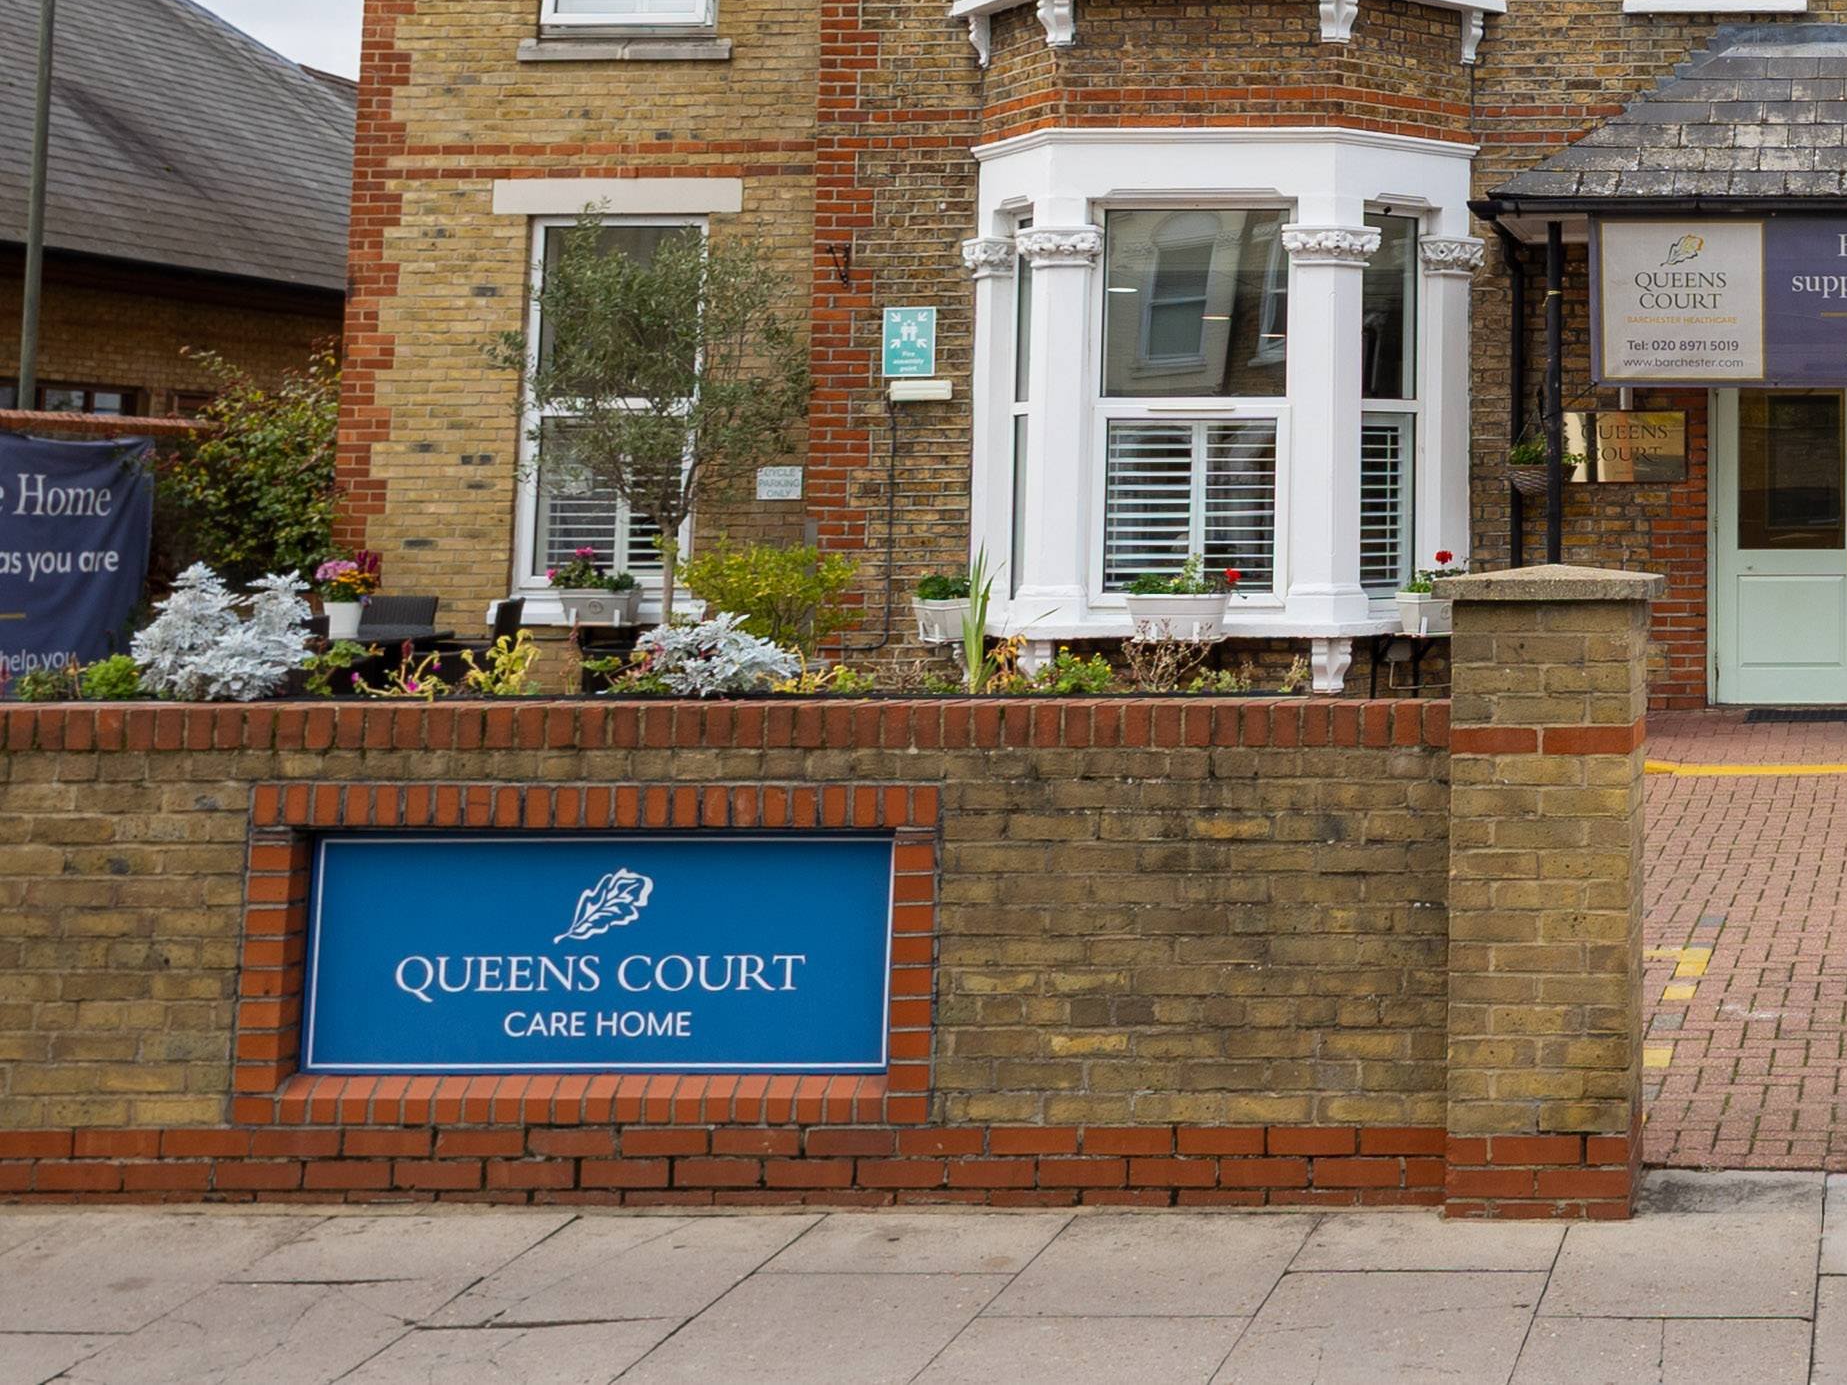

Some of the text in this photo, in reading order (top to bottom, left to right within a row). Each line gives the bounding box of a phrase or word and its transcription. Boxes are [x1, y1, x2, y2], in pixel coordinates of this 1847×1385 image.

[1634, 271, 1727, 292] QUEENS
[1639, 293, 1722, 310] COURT
[1627, 316, 1738, 324] BARCHESTER HEALTHCARE
[1627, 340, 1739, 351] Tel: 020 8971 5019
[1623, 356, 1743, 368] www.barchester.com
[1588, 445, 1662, 463] OURT
[764, 468, 796, 477] CYCLE
[758, 478, 800, 487] PARKING
[13, 473, 112, 517] Home
[766, 489, 792, 498] ONLY
[27, 551, 72, 582] you
[78, 549, 120, 573] are
[0, 648, 38, 675] help
[394, 954, 806, 1003] QUEENS COURT
[503, 1011, 692, 1038] CARE HOME
